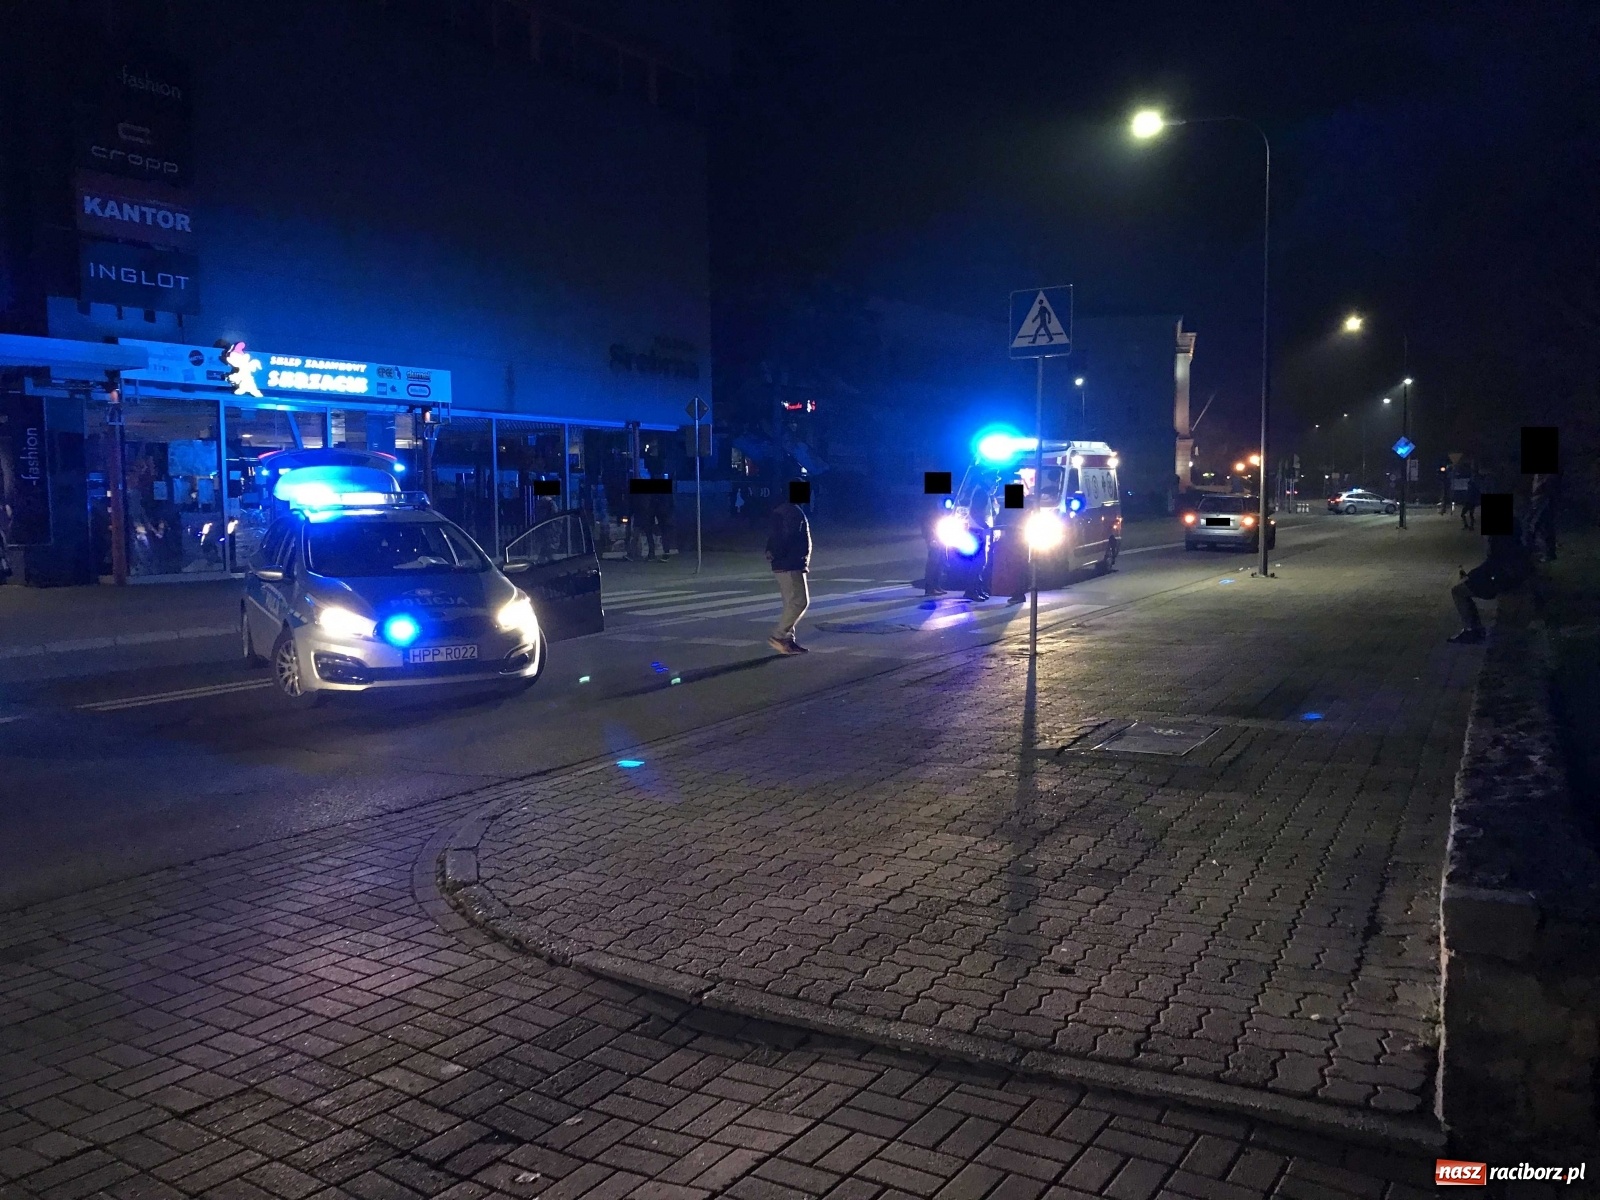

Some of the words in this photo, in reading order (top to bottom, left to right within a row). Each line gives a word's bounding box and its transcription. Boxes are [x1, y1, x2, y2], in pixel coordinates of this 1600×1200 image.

[91, 145, 179, 174] cropp
[83, 195, 192, 233] KANTOR
[89, 262, 190, 290] INGLOT
[389, 597, 468, 607] POLICJA
[411, 648, 441, 662] HPP
[446, 645, 476, 660] R022
